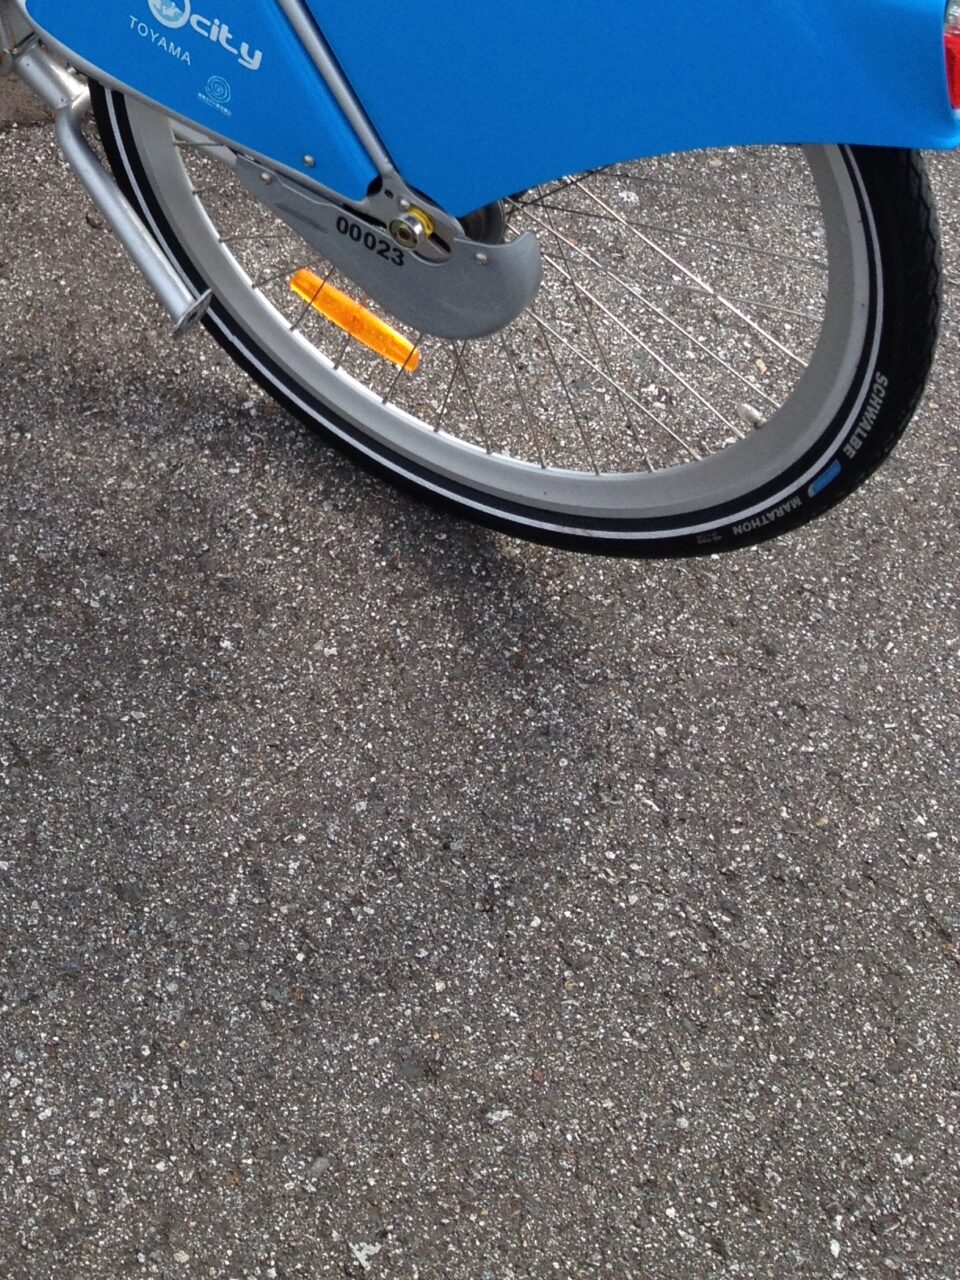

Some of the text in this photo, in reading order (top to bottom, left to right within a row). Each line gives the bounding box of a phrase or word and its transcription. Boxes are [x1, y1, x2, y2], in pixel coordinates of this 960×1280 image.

[129, 15, 193, 66] TOYAMA
[336, 216, 405, 267] 00023
[845, 371, 889, 461] SCHWALBE
[732, 496, 803, 536] MARATHON
